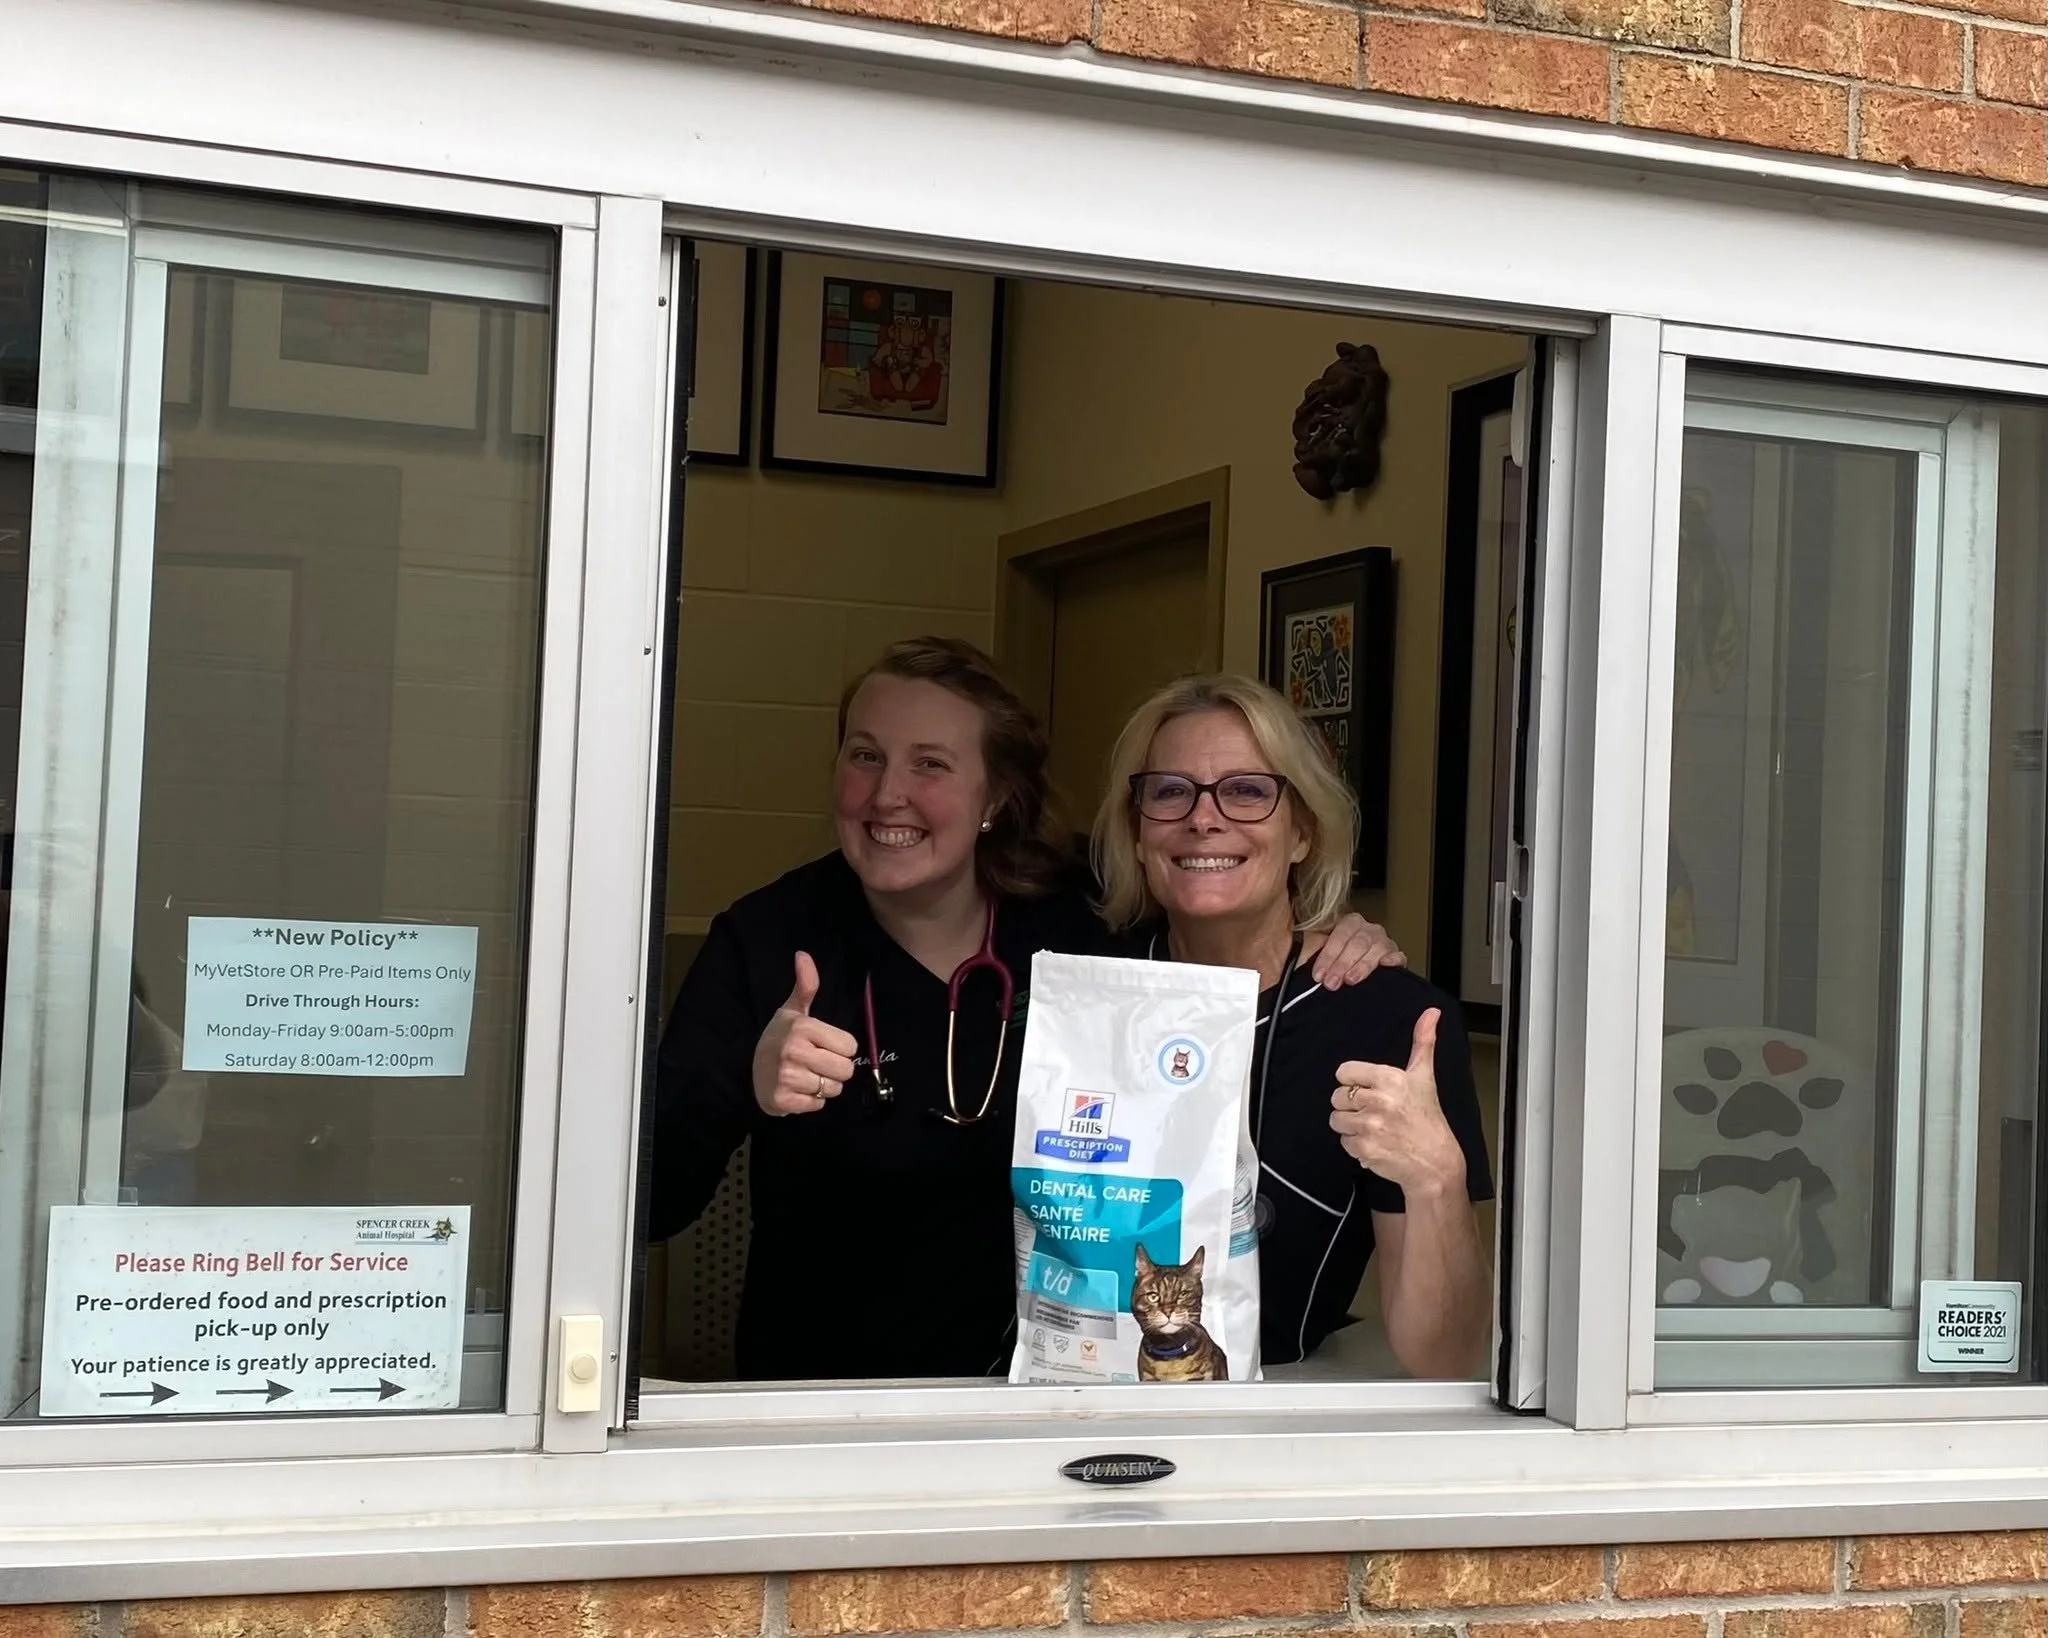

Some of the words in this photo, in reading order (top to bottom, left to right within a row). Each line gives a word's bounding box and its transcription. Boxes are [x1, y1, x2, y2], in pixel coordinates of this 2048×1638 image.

[194, 964, 286, 979] MyVetStore
[290, 965, 314, 978] OR
[319, 965, 383, 979] Pre-Paid
[388, 966, 431, 979] Items
[435, 966, 471, 982] Only
[246, 994, 289, 1008] Drive
[293, 994, 360, 1011] Through
[365, 995, 419, 1009] Hours:
[207, 1024, 325, 1041] Monday-Friday
[329, 1025, 454, 1040] 9:00am-5:00pm
[225, 1053, 297, 1069] Saturday
[301, 1054, 434, 1069] 8:00am-12:00pm
[1069, 1119, 1103, 1135] Hill's
[1043, 1136, 1123, 1153] PRESCRIPTION
[1069, 1149, 1094, 1160] DIET
[1030, 1179, 1097, 1199] DENTAL
[1103, 1186, 1152, 1203] CARE
[1030, 1204, 1084, 1222] SANTÉ
[356, 1218, 397, 1229] SPENCER
[400, 1219, 430, 1229] CREEK
[356, 1231, 383, 1239] Animal
[385, 1231, 415, 1241] Hospital
[115, 1253, 185, 1273] Please
[193, 1253, 238, 1277] Ring
[246, 1252, 284, 1272] Bell
[292, 1252, 323, 1271] for
[330, 1252, 408, 1272] Service
[1043, 1266, 1073, 1296] t/d
[76, 1292, 211, 1311] Pre-ordered
[218, 1291, 268, 1310] food
[275, 1291, 312, 1309] and
[318, 1290, 447, 1315] prescription
[1938, 1310, 2007, 1324] READERS'
[195, 1318, 277, 1342] pick-up
[284, 1317, 330, 1341] only
[1938, 1326, 1981, 1337] CHOICE
[1984, 1326, 2006, 1338] 2021
[71, 1358, 116, 1375] Your
[123, 1355, 210, 1378] patience
[215, 1355, 230, 1371] is
[237, 1353, 309, 1376] greatly
[315, 1352, 437, 1374] appreciated.
[1082, 1461, 1156, 1480] QUIKSERV
